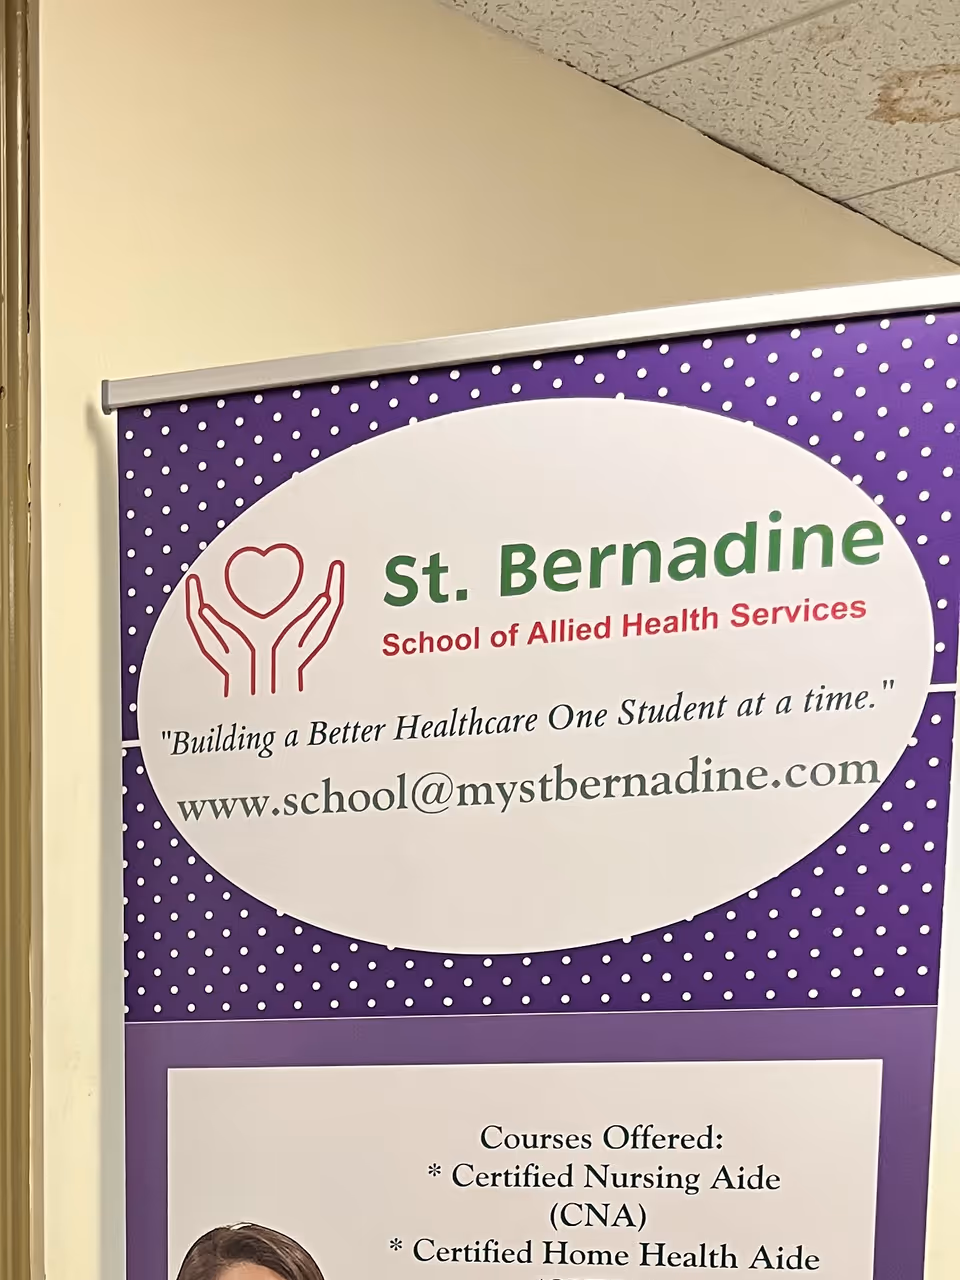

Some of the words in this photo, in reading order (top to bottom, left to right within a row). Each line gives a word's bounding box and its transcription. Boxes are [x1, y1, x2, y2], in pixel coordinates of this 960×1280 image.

[384, 553, 467, 606] St.
[501, 511, 883, 596] Bernadine
[383, 627, 479, 656] School
[491, 623, 519, 647] of
[527, 616, 610, 644] Allied
[623, 607, 717, 637] Health
[731, 598, 866, 627] Services
[162, 723, 276, 758] "Building
[285, 730, 298, 747] a
[307, 721, 386, 745] Better
[393, 706, 537, 740] Healthcare
[549, 704, 607, 730] One
[618, 691, 727, 725] Student
[737, 693, 765, 717] at
[776, 696, 791, 714] a
[804, 680, 894, 712] time."
[176, 755, 881, 823] www.school@mystbernadine.com
[481, 1125, 591, 1149] Courses
[604, 1124, 722, 1149] Offered:
[453, 1163, 573, 1187] Certified
[584, 1164, 700, 1195] Nursing
[710, 1165, 780, 1189] Aide
[551, 1203, 646, 1232] (CNA)
[414, 1239, 532, 1263] Certified
[543, 1241, 628, 1265] Home
[639, 1243, 738, 1268] Health
[749, 1245, 819, 1270] Aide
